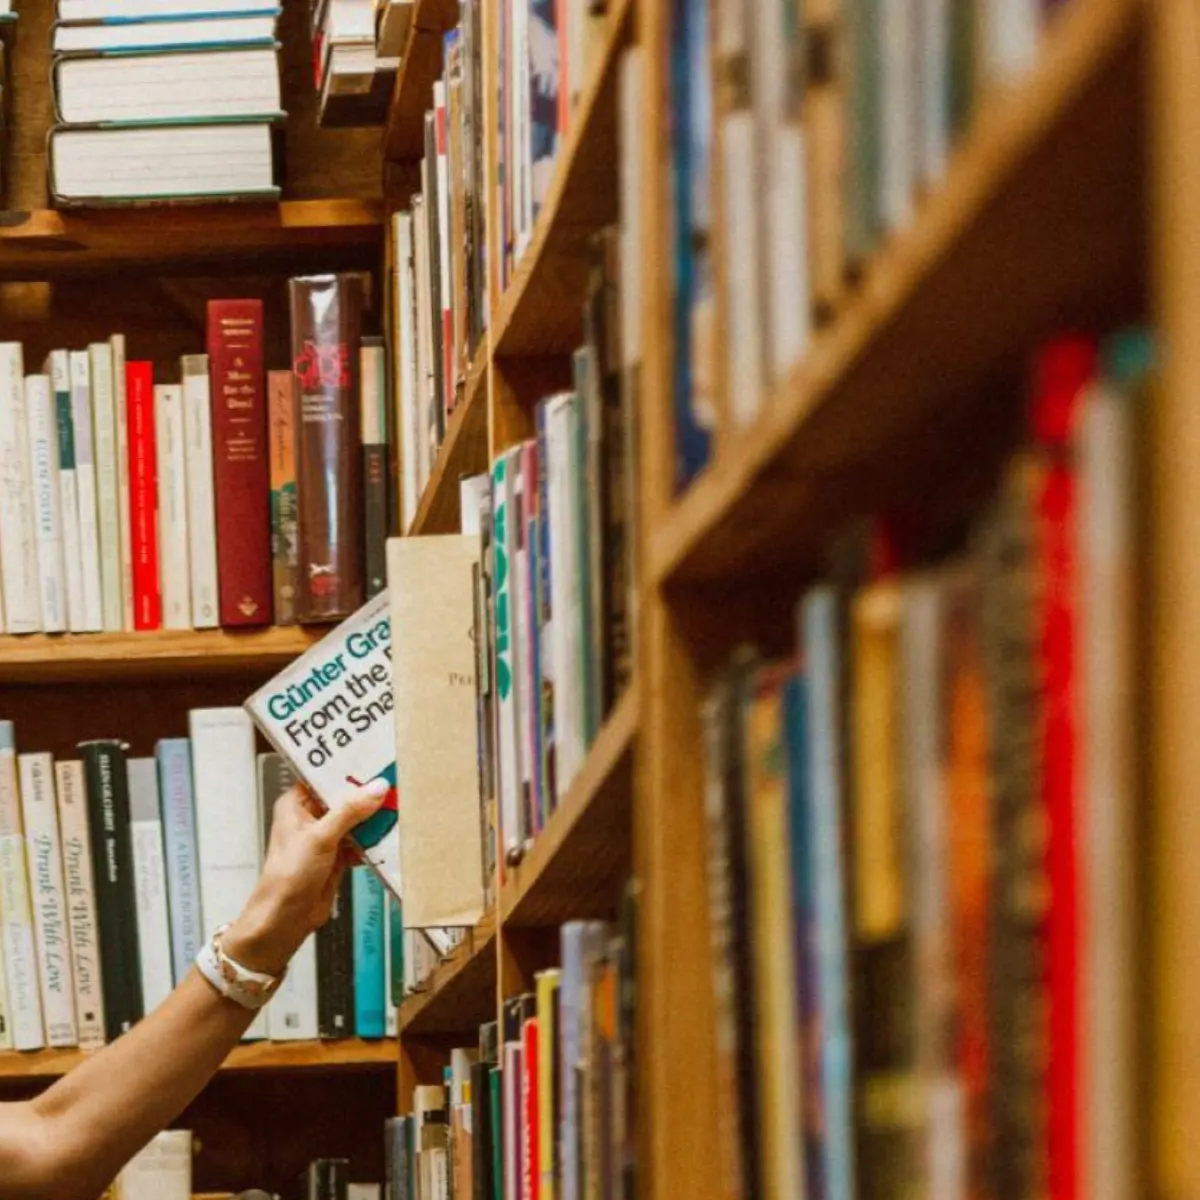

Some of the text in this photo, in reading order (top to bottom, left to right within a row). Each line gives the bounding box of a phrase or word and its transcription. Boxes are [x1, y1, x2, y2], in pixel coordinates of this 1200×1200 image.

[267, 613, 393, 721] Günter Gra
[283, 663, 390, 747] From the
[100, 754, 113, 784] ELLEN
[307, 738, 334, 768] of
[336, 726, 352, 748] a
[172, 754, 187, 827] GILCHRIST
[34, 835, 63, 994] Drunk With Love
[65, 837, 95, 995] Drunk With Love
[178, 855, 194, 935] DANGEROUS
